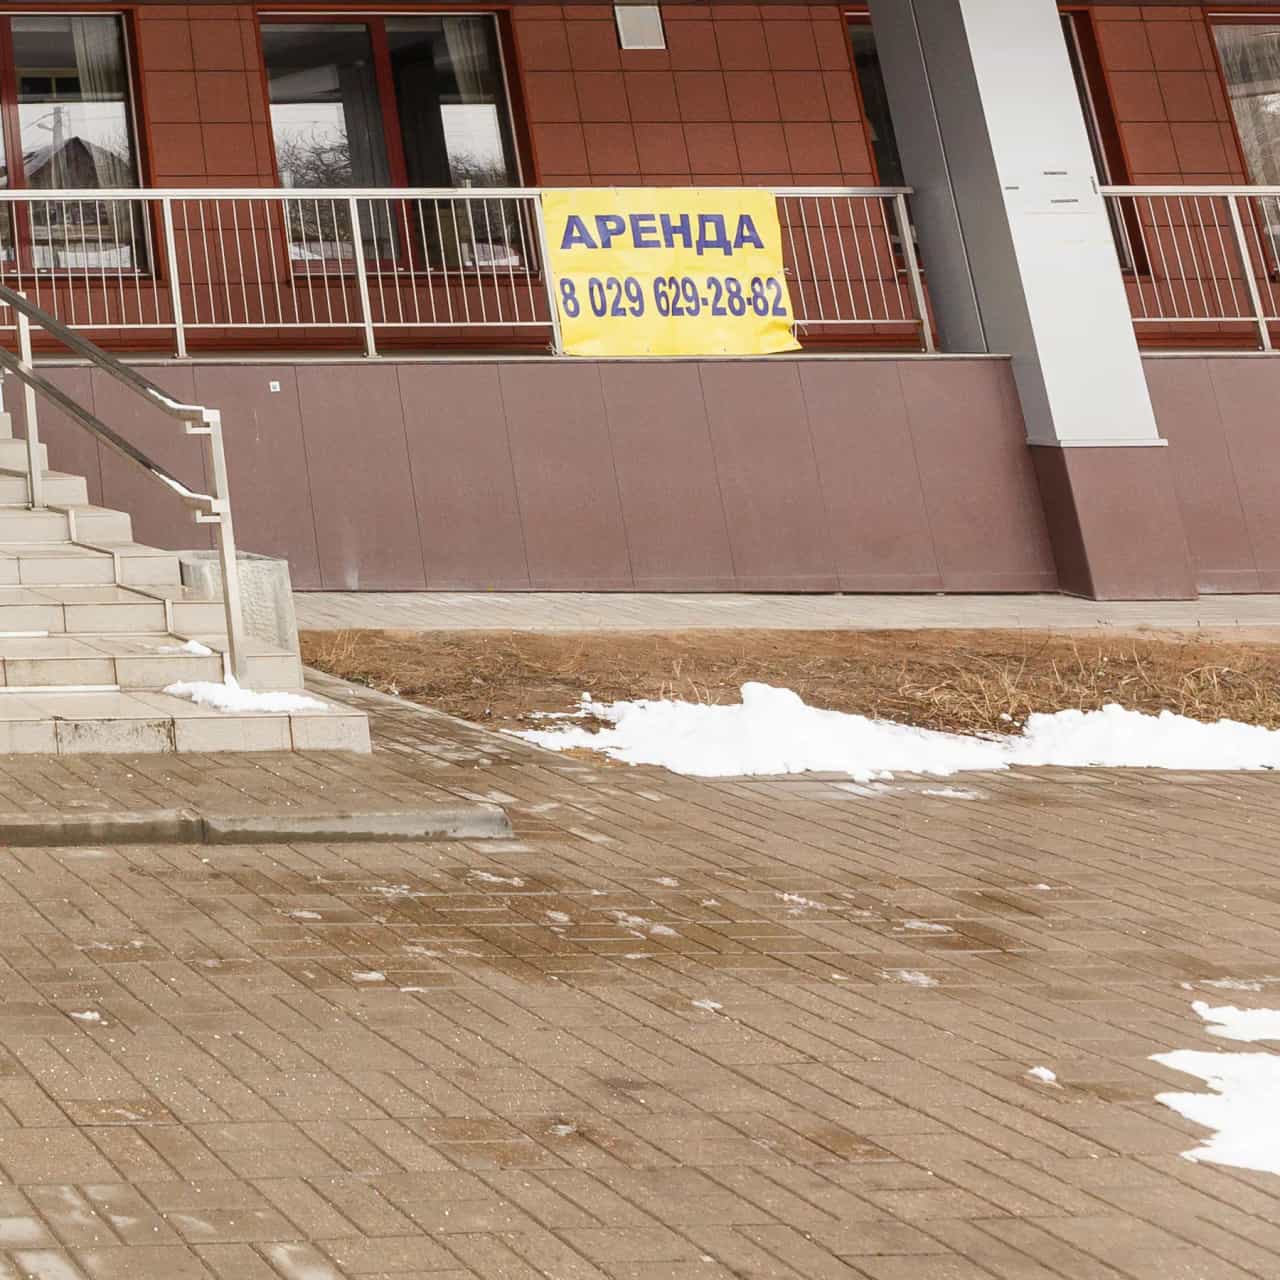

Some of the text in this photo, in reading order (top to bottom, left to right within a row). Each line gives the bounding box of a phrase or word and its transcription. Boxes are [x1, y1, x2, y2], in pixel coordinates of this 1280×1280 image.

[559, 213, 764, 256] АРЕНДА
[559, 276, 787, 318] 8 029 629-28-82
